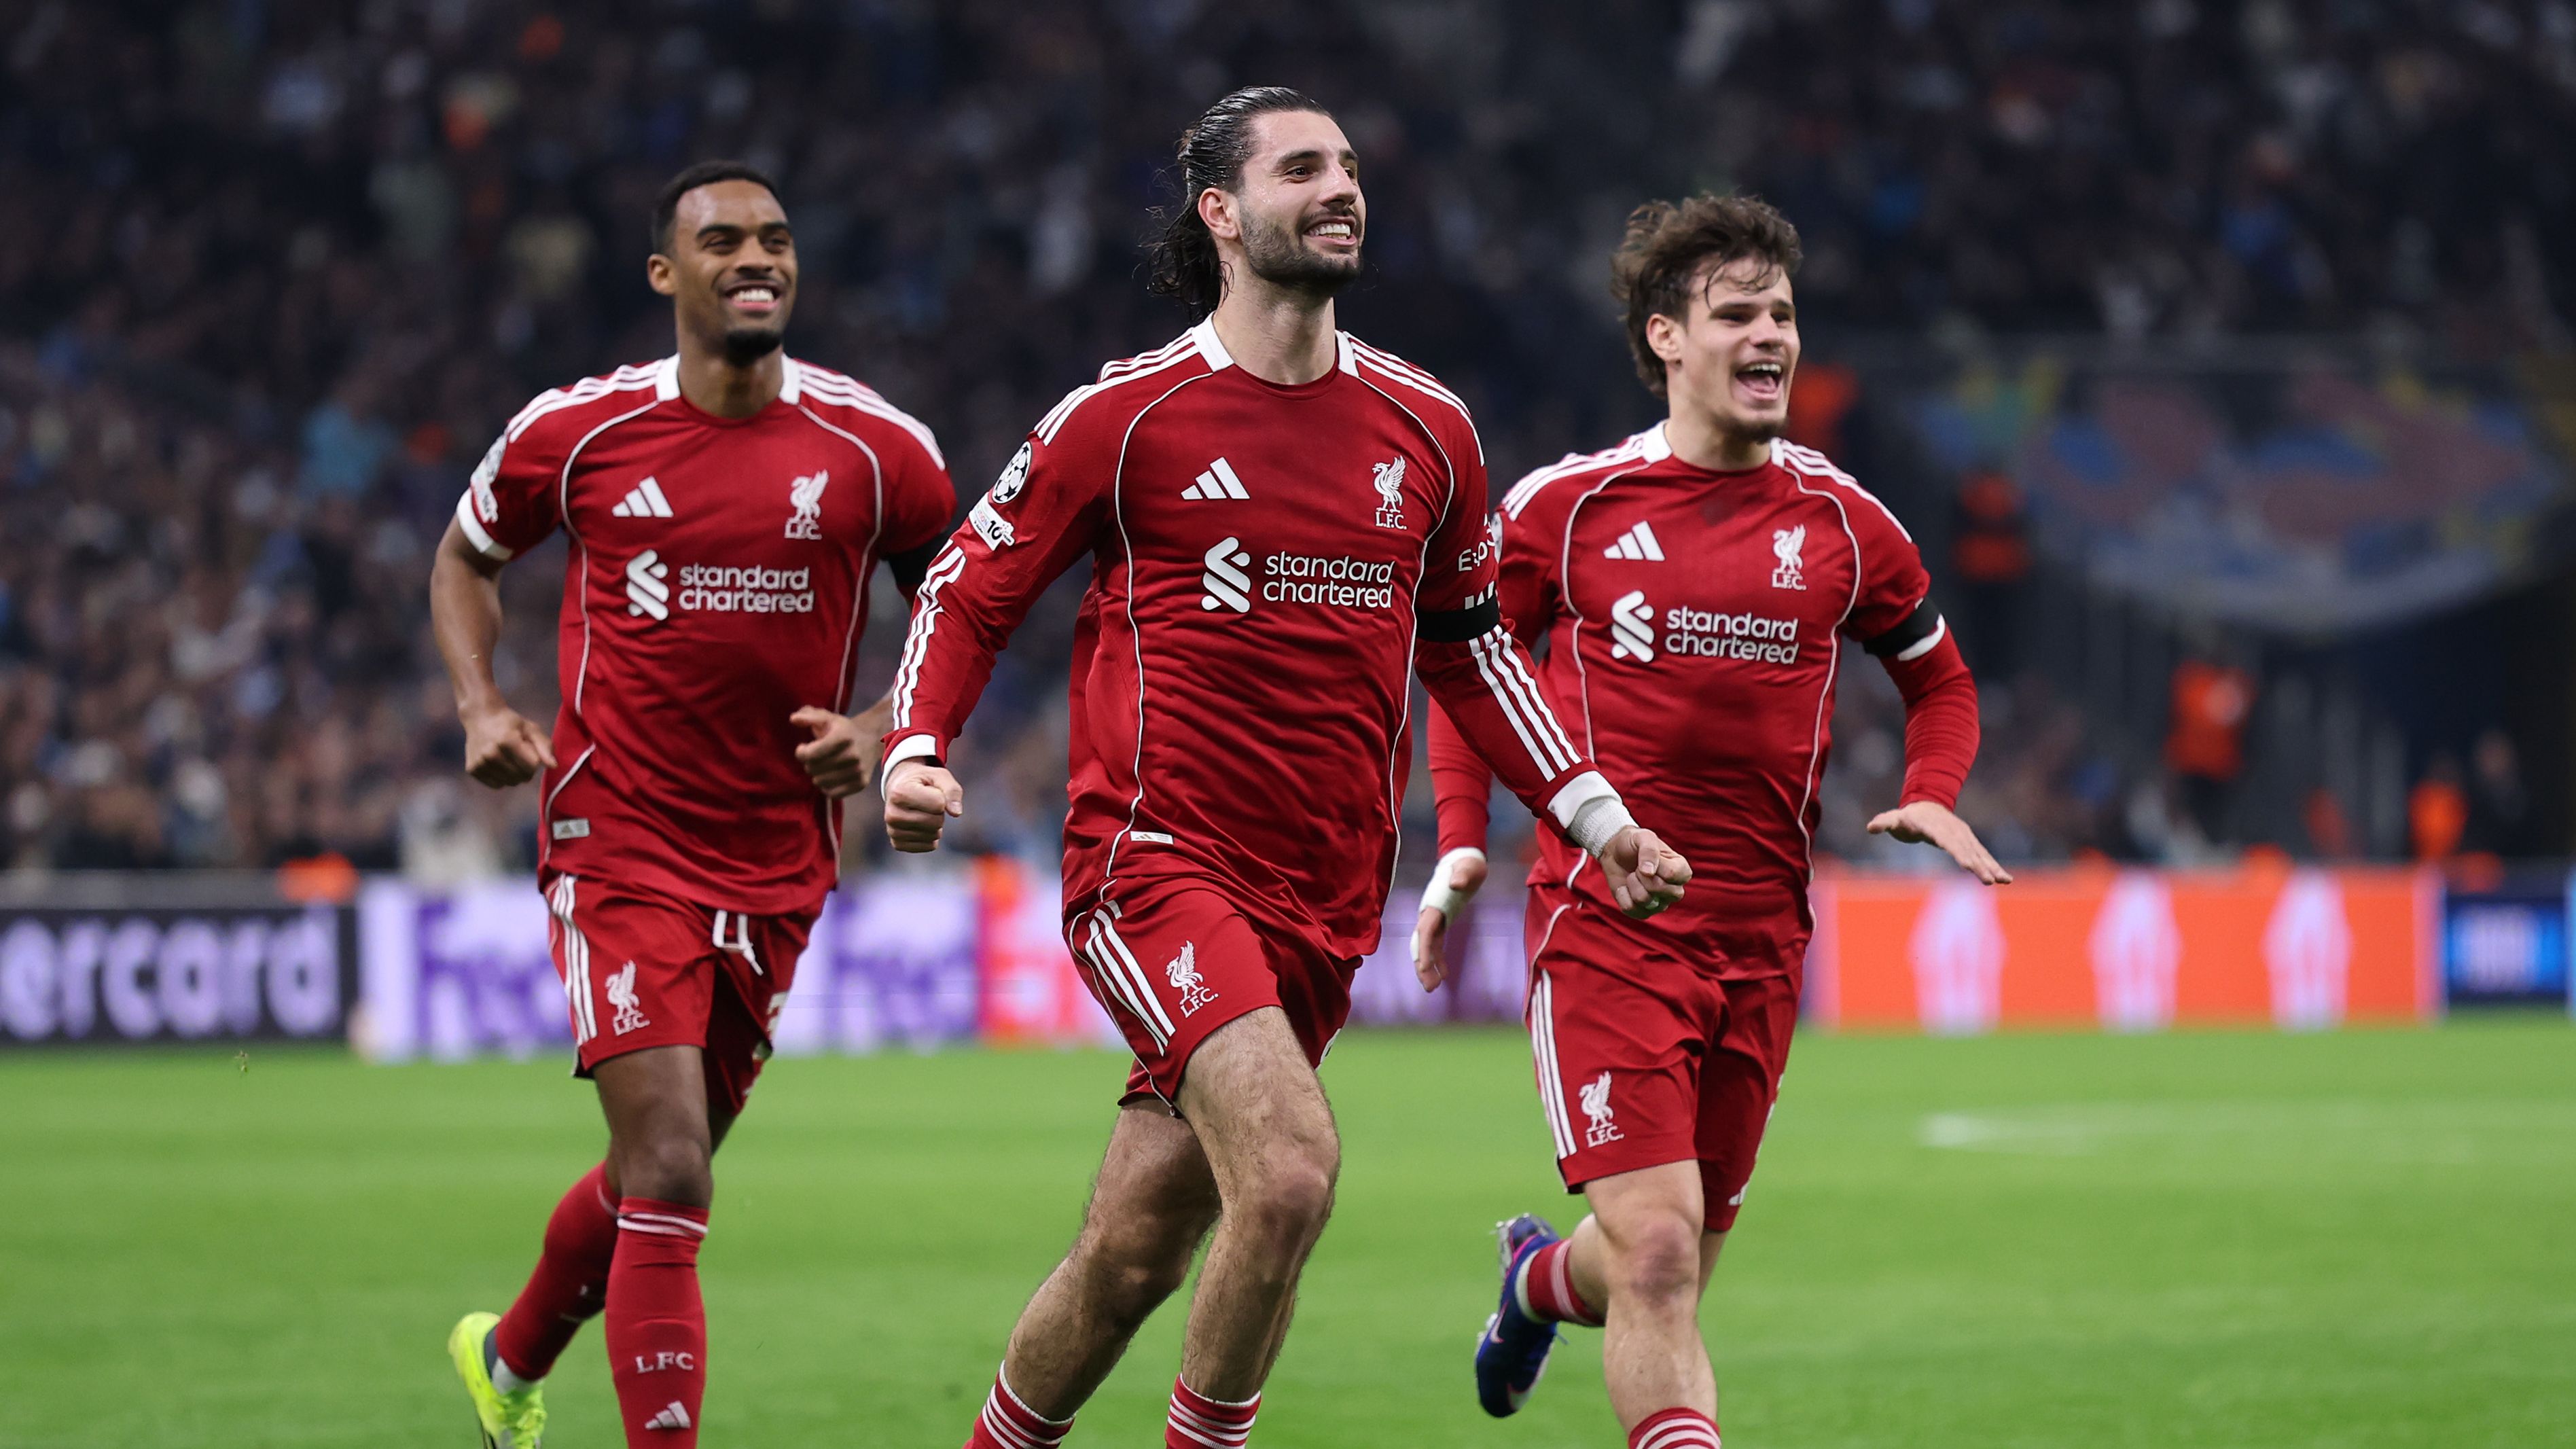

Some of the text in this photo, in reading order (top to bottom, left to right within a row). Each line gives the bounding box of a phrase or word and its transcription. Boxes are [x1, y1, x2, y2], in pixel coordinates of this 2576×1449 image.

[679, 562, 810, 590] standard
[1265, 551, 1395, 584] standard
[679, 586, 815, 613] chartered
[1263, 577, 1393, 609] chartered
[1666, 605, 1799, 642] standard
[1665, 630, 1800, 665] chartered
[635, 1351, 694, 1374] LFC
